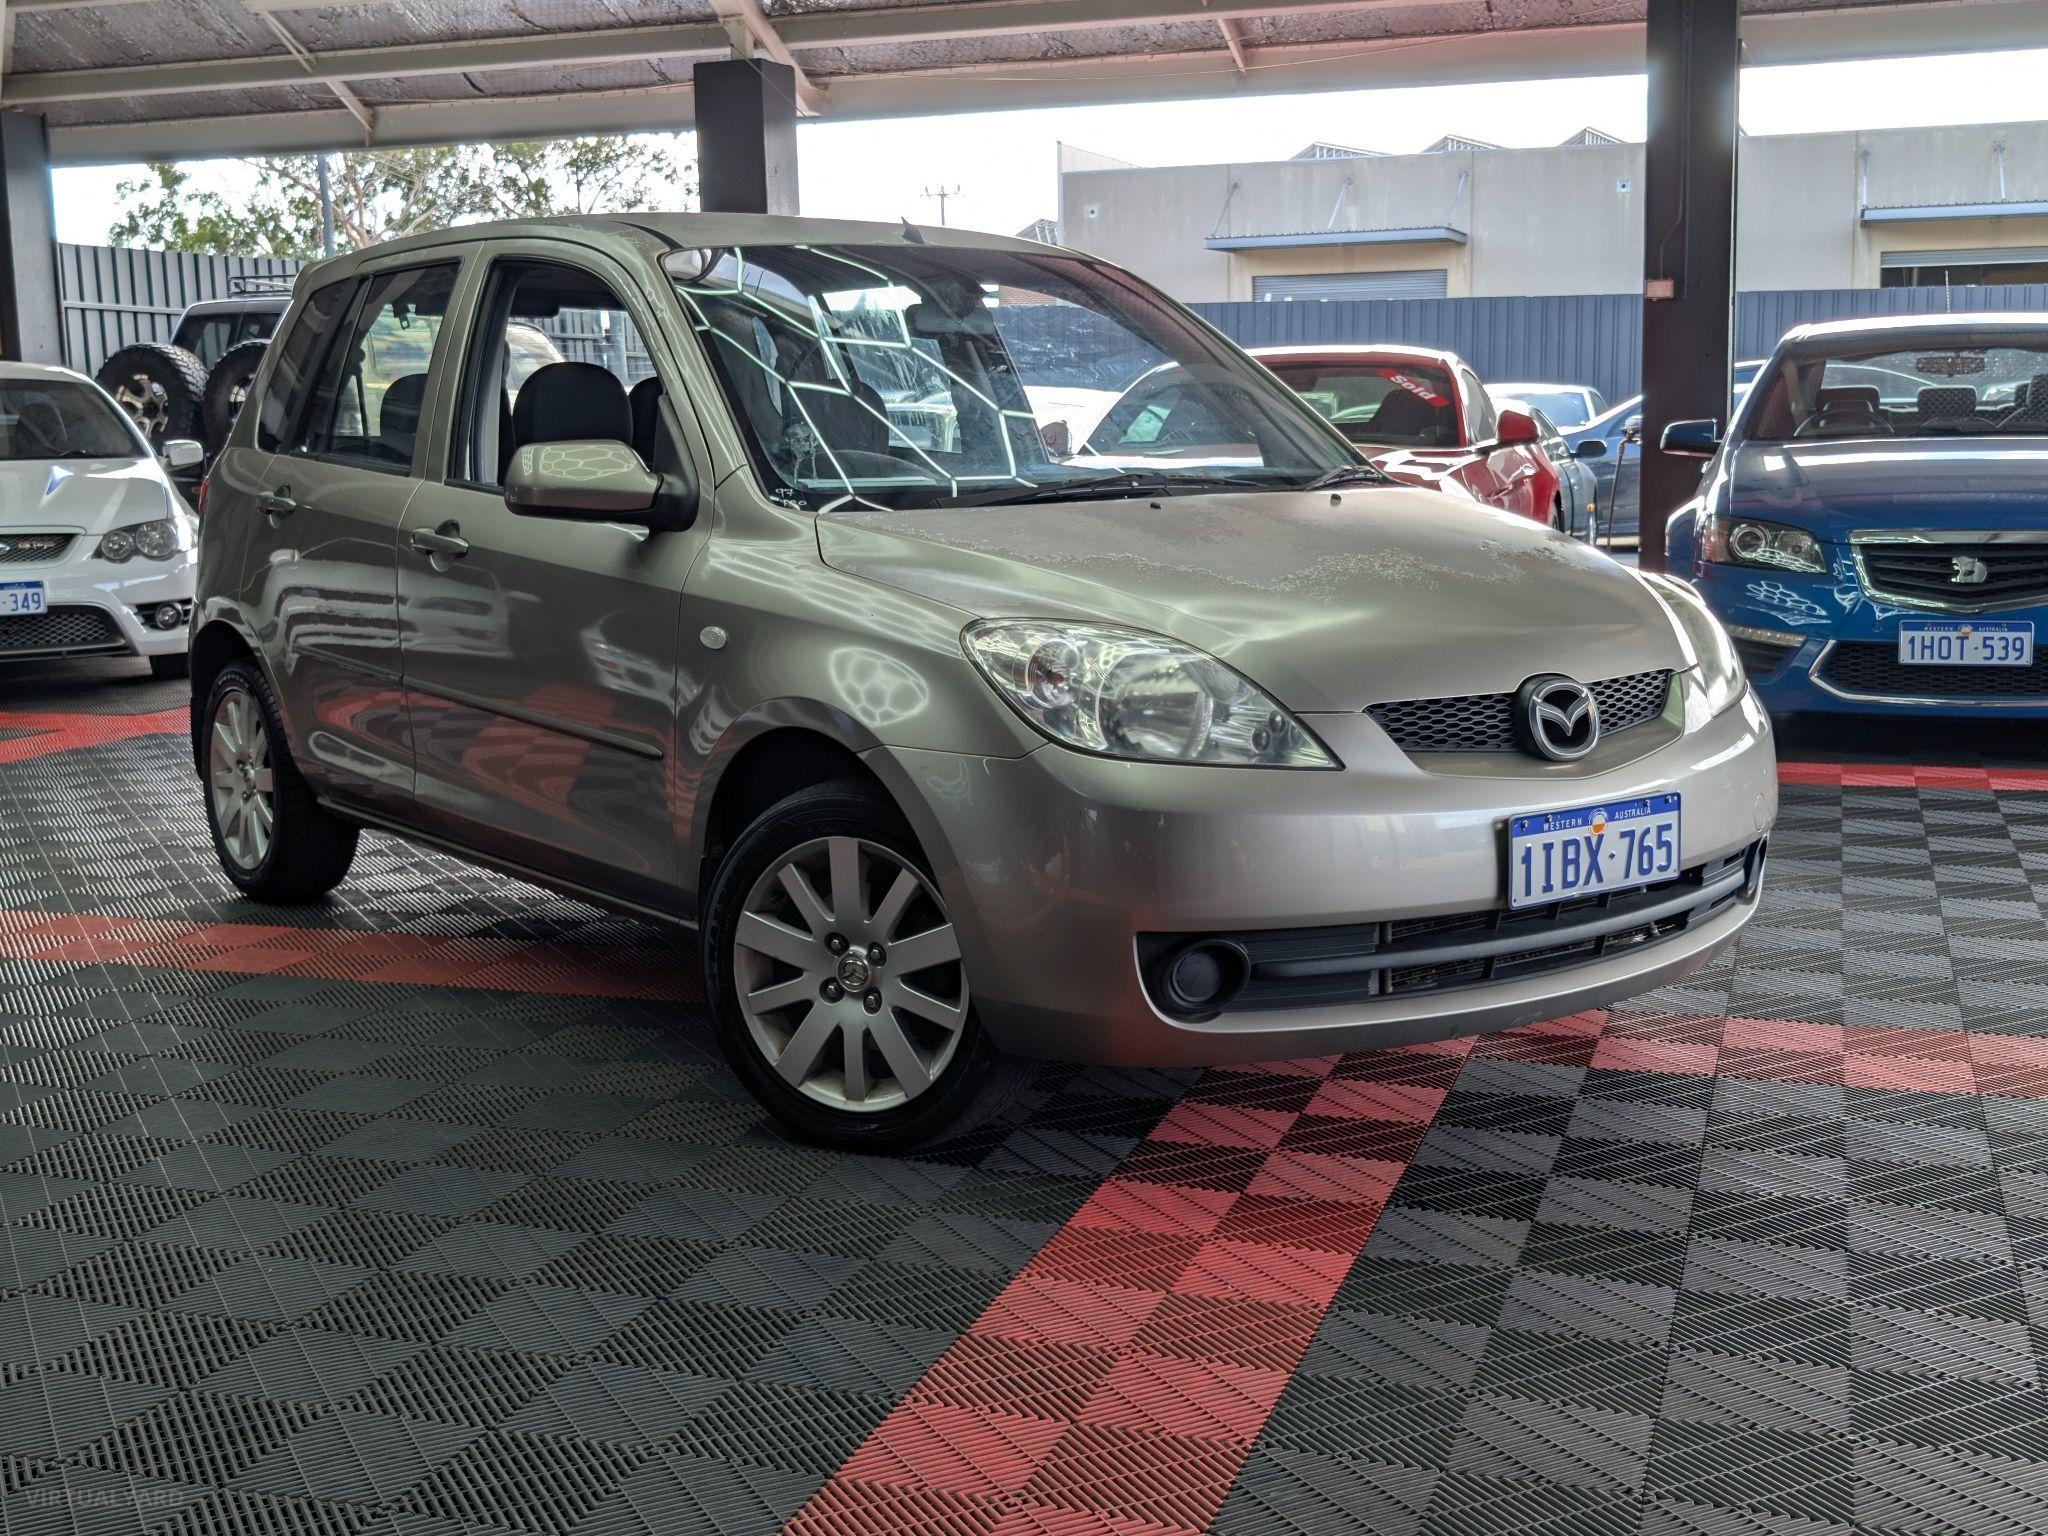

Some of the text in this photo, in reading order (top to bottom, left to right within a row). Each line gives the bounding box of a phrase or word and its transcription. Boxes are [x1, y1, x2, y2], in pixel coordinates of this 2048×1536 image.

[1390, 375, 1437, 400] Sold
[1543, 807, 1652, 832] WESTERN AUSTRALIA
